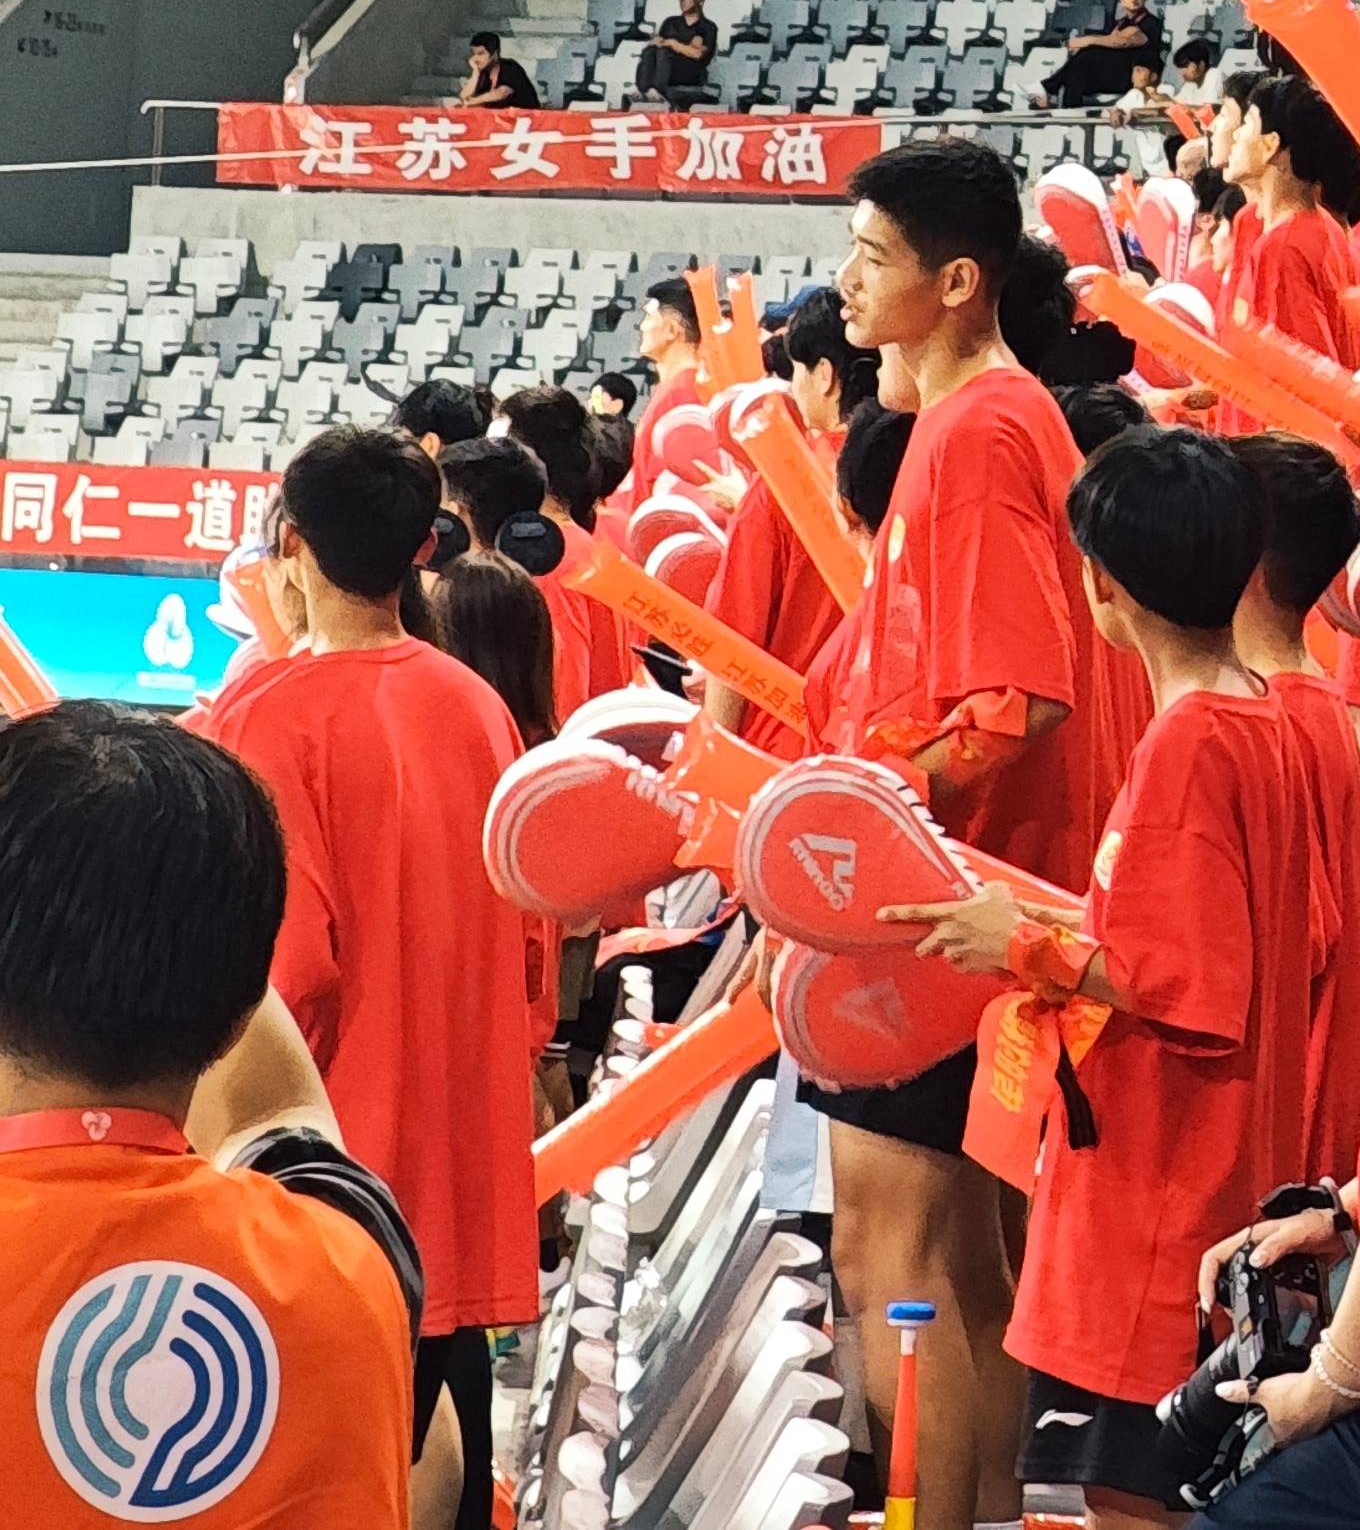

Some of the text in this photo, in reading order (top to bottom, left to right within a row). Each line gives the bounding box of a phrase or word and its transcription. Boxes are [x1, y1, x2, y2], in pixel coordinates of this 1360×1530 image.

[300, 114, 827, 185] 江苏女手加油
